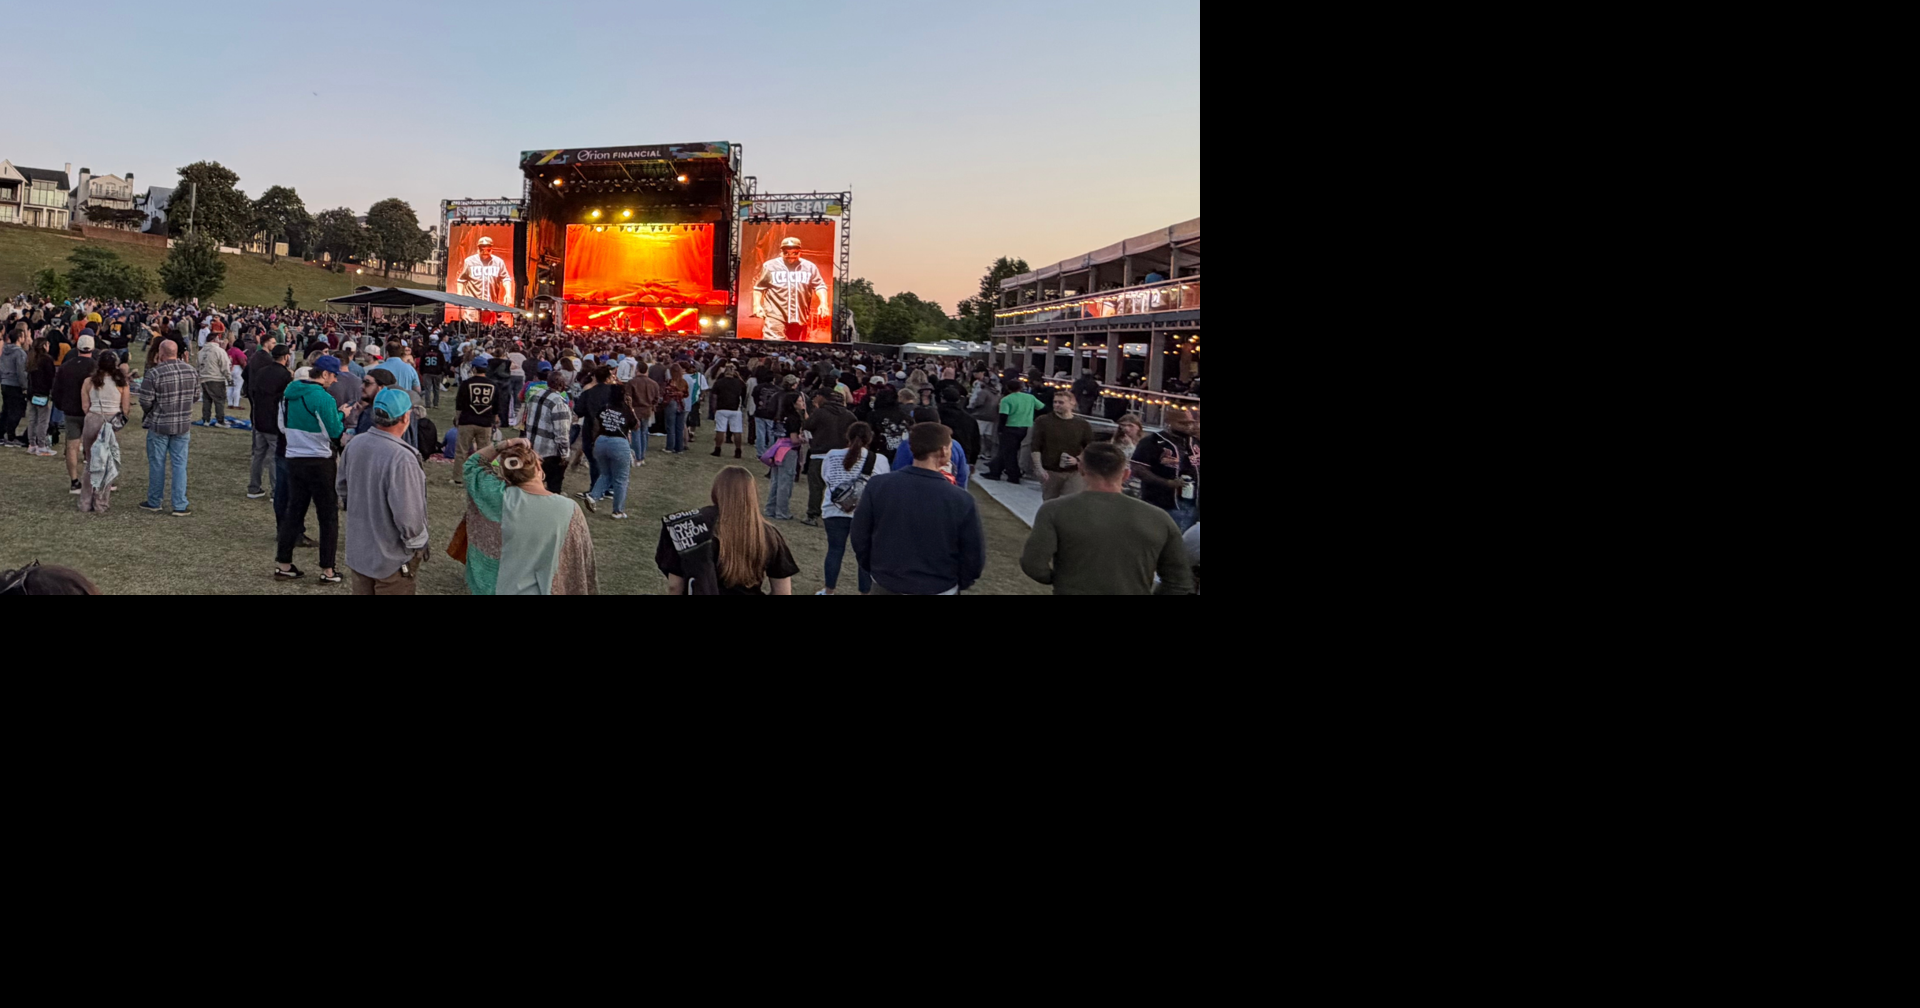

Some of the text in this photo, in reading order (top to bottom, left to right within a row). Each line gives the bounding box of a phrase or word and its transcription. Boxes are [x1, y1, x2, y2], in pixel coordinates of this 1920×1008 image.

[612, 150, 662, 159] FINANCIAL
[752, 201, 829, 214] RIVERBEAT
[771, 271, 787, 284] ICE
[424, 356, 438, 366] 36
[674, 520, 695, 533] FAC
